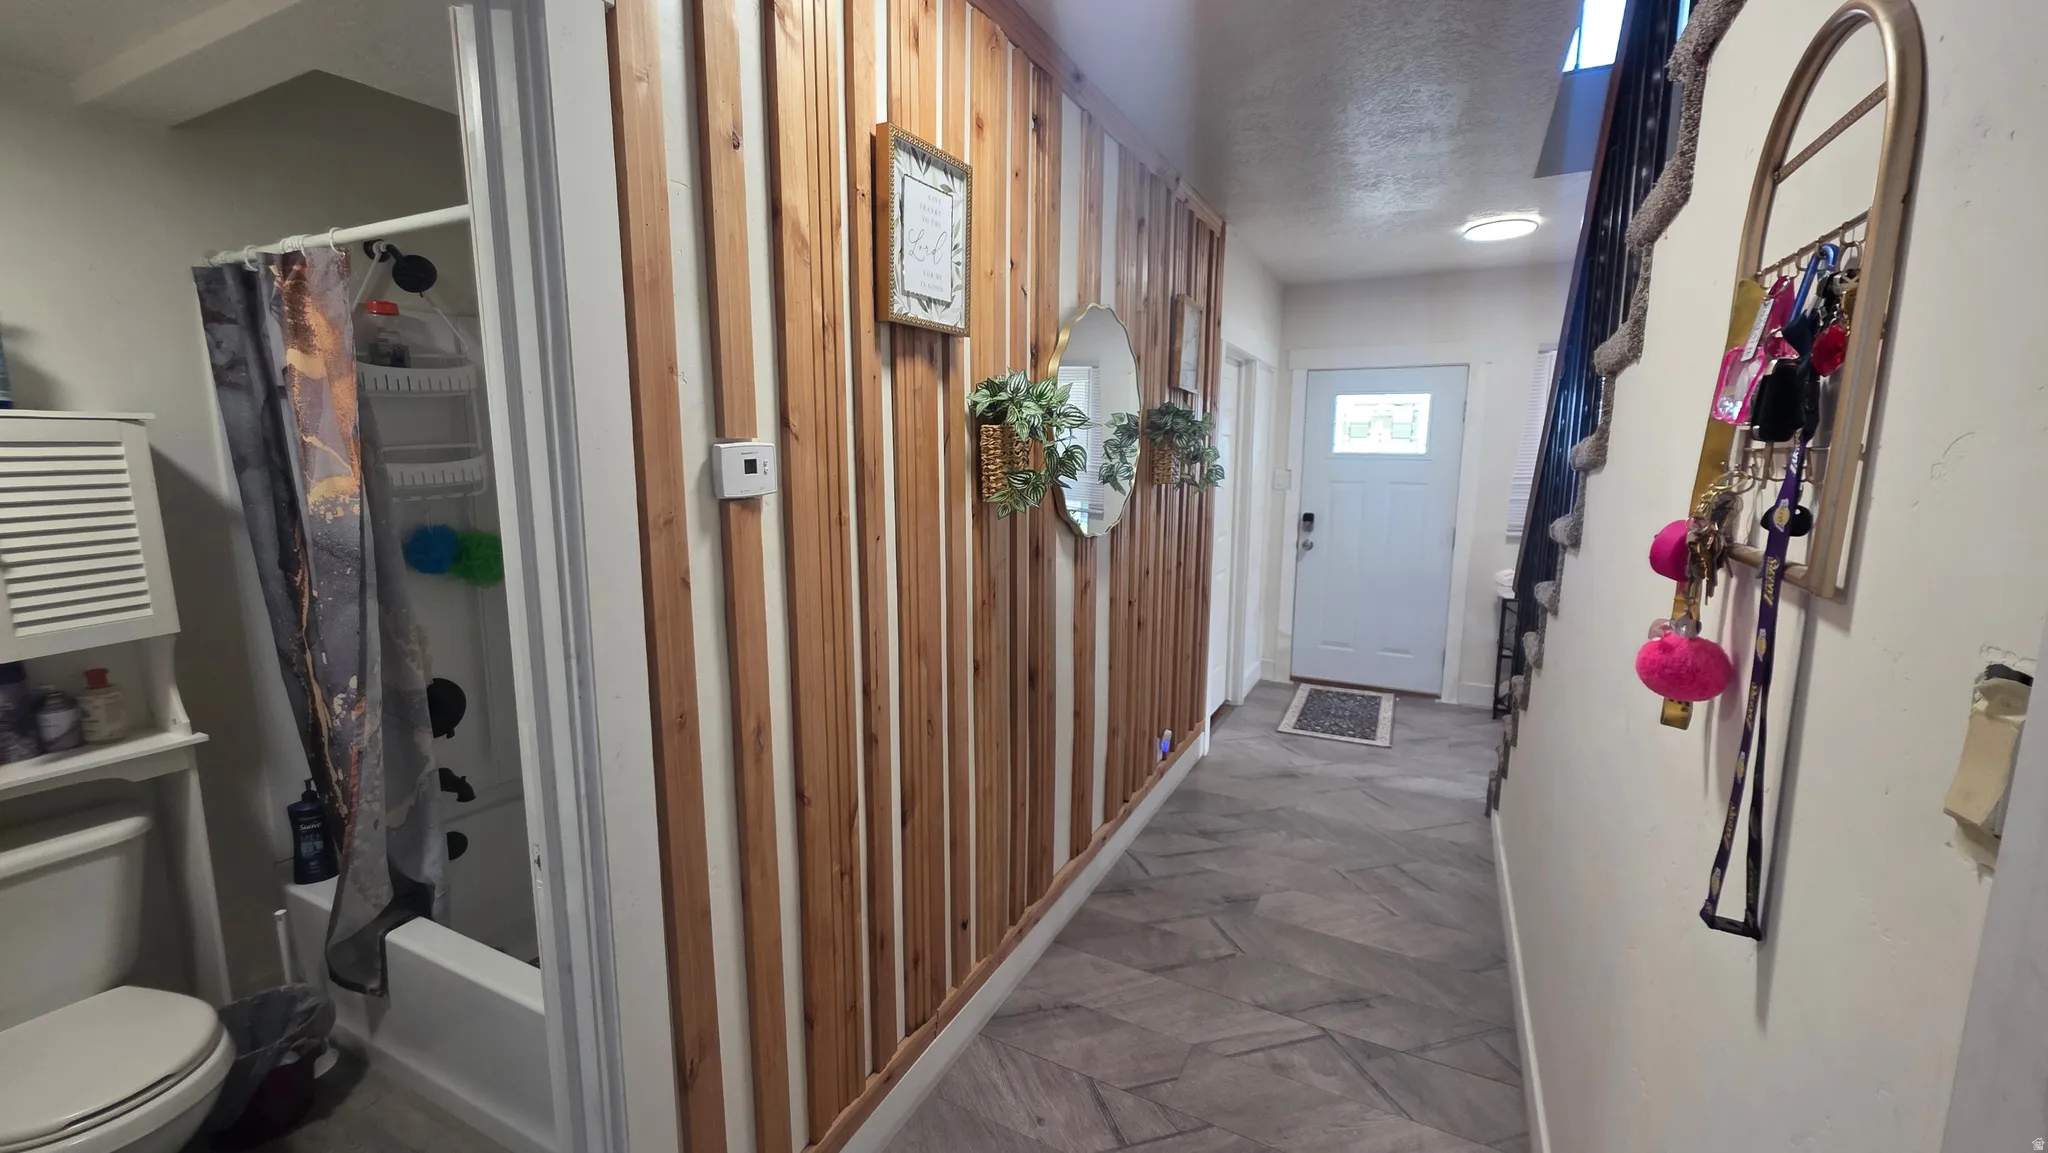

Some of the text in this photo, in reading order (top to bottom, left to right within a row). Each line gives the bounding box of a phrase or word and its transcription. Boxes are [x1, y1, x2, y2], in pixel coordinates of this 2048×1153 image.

[908, 228, 948, 265] Lord
[1764, 556, 1780, 606] LAKERS
[299, 822, 322, 831] Suave
